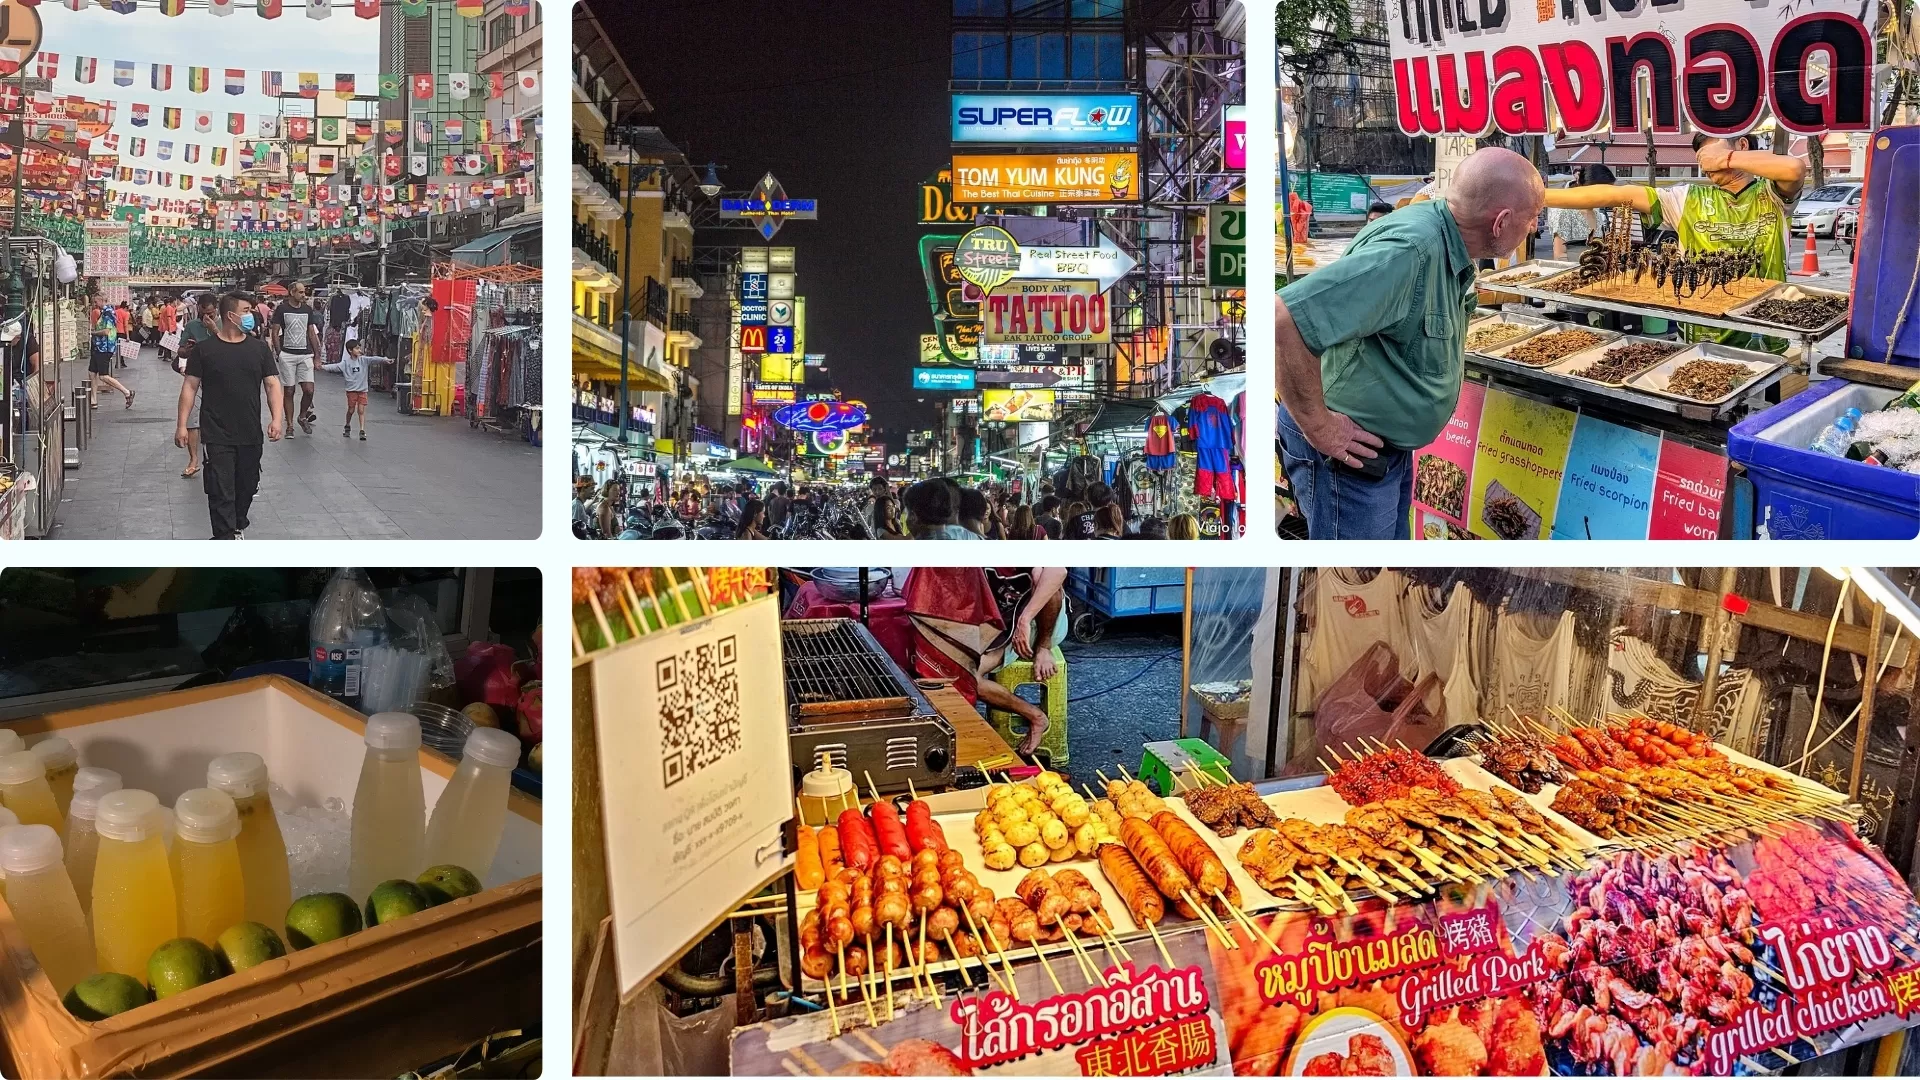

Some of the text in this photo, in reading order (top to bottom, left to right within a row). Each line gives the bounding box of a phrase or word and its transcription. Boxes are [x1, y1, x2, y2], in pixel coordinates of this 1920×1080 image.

[1393, 13, 1875, 135] แมลงทอด
[1443, 138, 1474, 156] TAKE
[958, 166, 1105, 187] TOM YUM KUNG
[962, 189, 1054, 198] The Best Thai Cuisine
[971, 238, 1008, 251] TRU
[1030, 249, 1118, 260] Real Street Food
[964, 251, 1012, 268] Street
[1057, 262, 1089, 275] BBQ
[1022, 284, 1048, 292] BODY
[1051, 284, 1071, 292] ART
[742, 313, 767, 321] CLINIC
[989, 294, 1106, 334] TATTOO
[774, 335, 786, 344] 24
[1446, 431, 1471, 448] beetle
[1500, 429, 1543, 456] ตั๊กแตนทอด
[1478, 441, 1563, 481] Fried grasshoppers
[1571, 473, 1596, 492] Fried
[1591, 463, 1629, 484] แมงป่อง
[1663, 490, 1694, 512] Fried
[1443, 913, 1495, 951] 烤豬
[1761, 917, 1890, 990] ไก่ย่าง
[1259, 922, 1439, 1008] หมูปิ้งนมสด
[1401, 946, 1547, 1027] Grilled Pork
[1887, 967, 1920, 1014] 烤
[957, 970, 1203, 1062] ไส้กรอกอีสาน
[1710, 980, 1888, 1076] grilled chicken
[1081, 1018, 1210, 1077] 東北香腸
